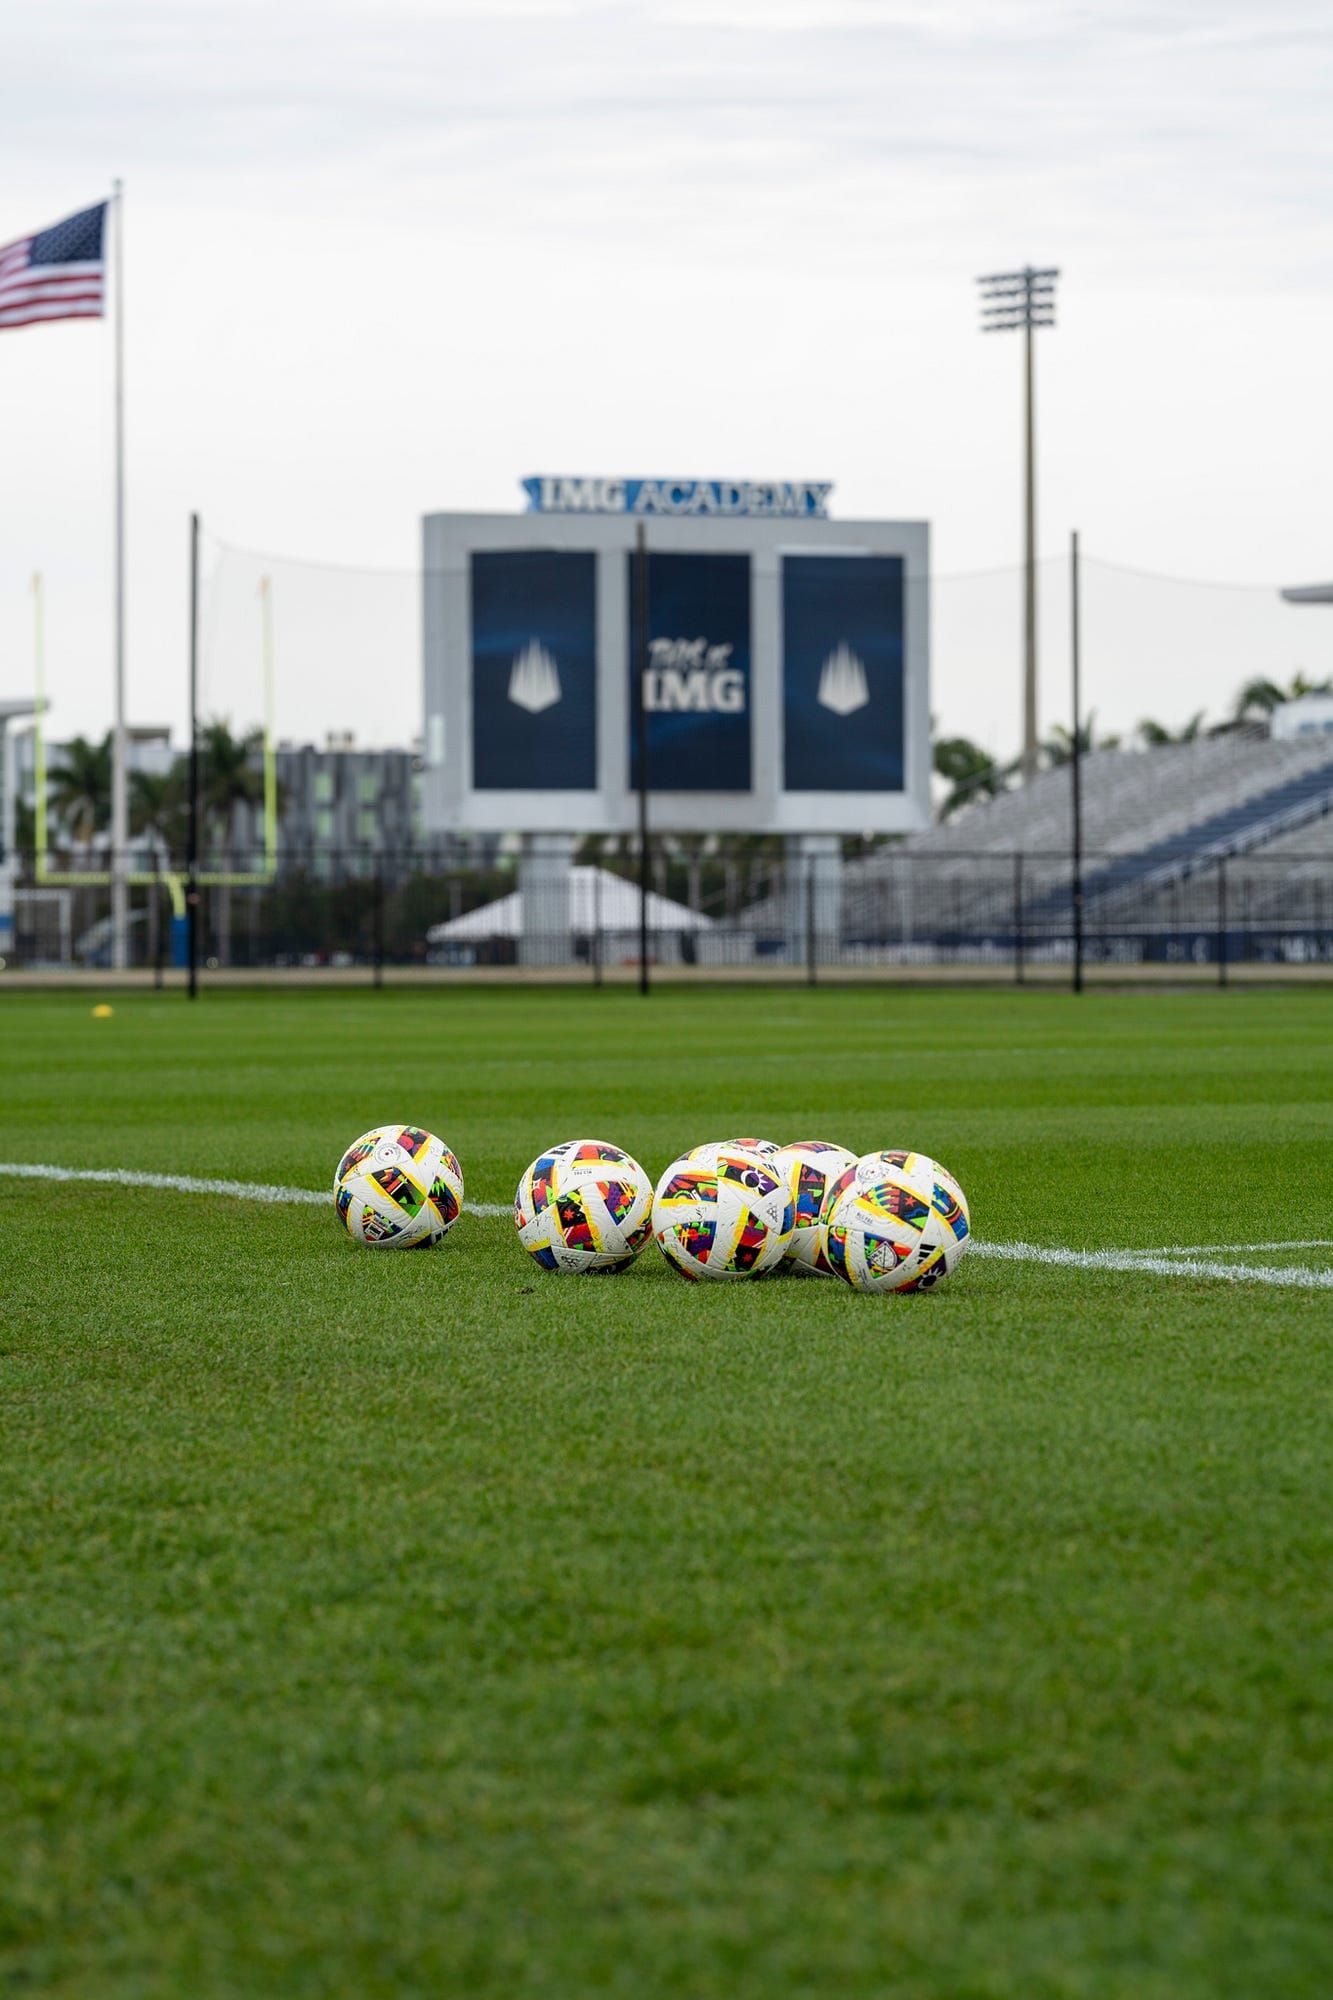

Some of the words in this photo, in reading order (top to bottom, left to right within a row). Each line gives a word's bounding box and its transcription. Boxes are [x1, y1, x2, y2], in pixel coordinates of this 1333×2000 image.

[541, 479, 626, 513] IMG
[634, 481, 831, 517] ACADEMY
[642, 668, 744, 713] IMG
